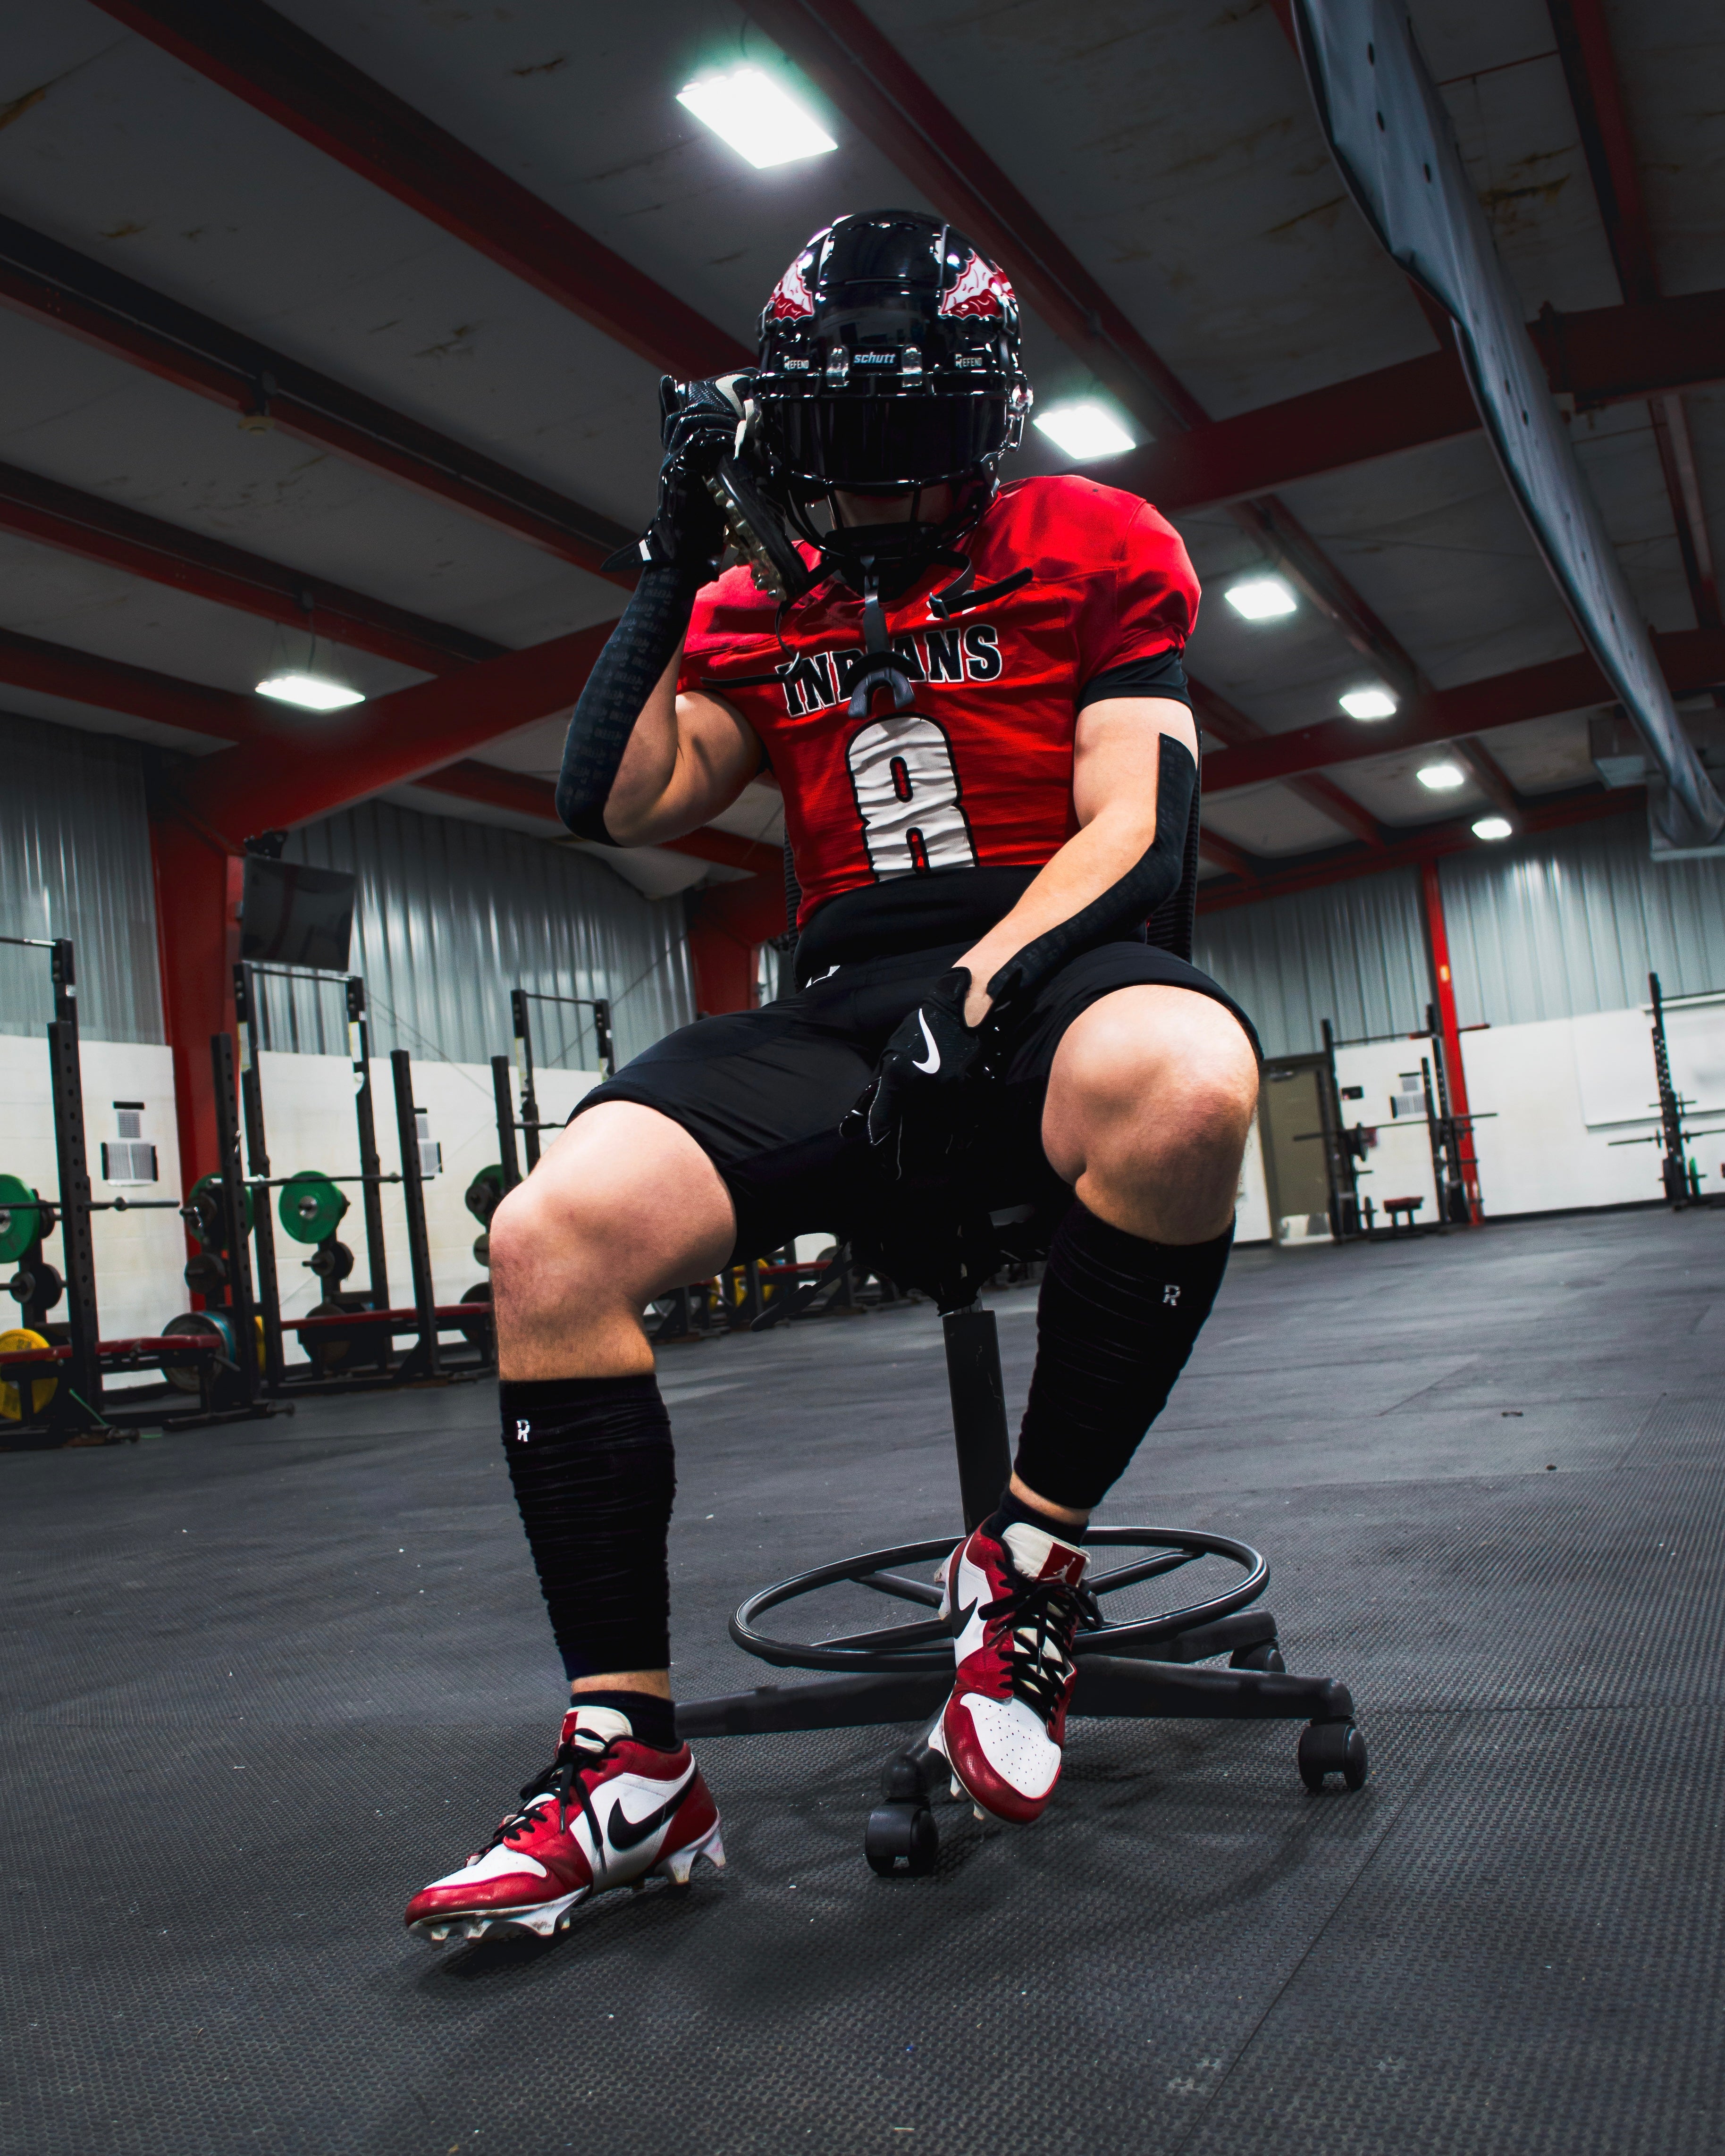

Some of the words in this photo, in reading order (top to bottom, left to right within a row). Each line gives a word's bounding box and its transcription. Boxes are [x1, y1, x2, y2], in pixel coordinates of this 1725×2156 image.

[853, 352, 896, 363] schutt
[774, 623, 1002, 718] INDANS
[845, 711, 980, 883] 8
